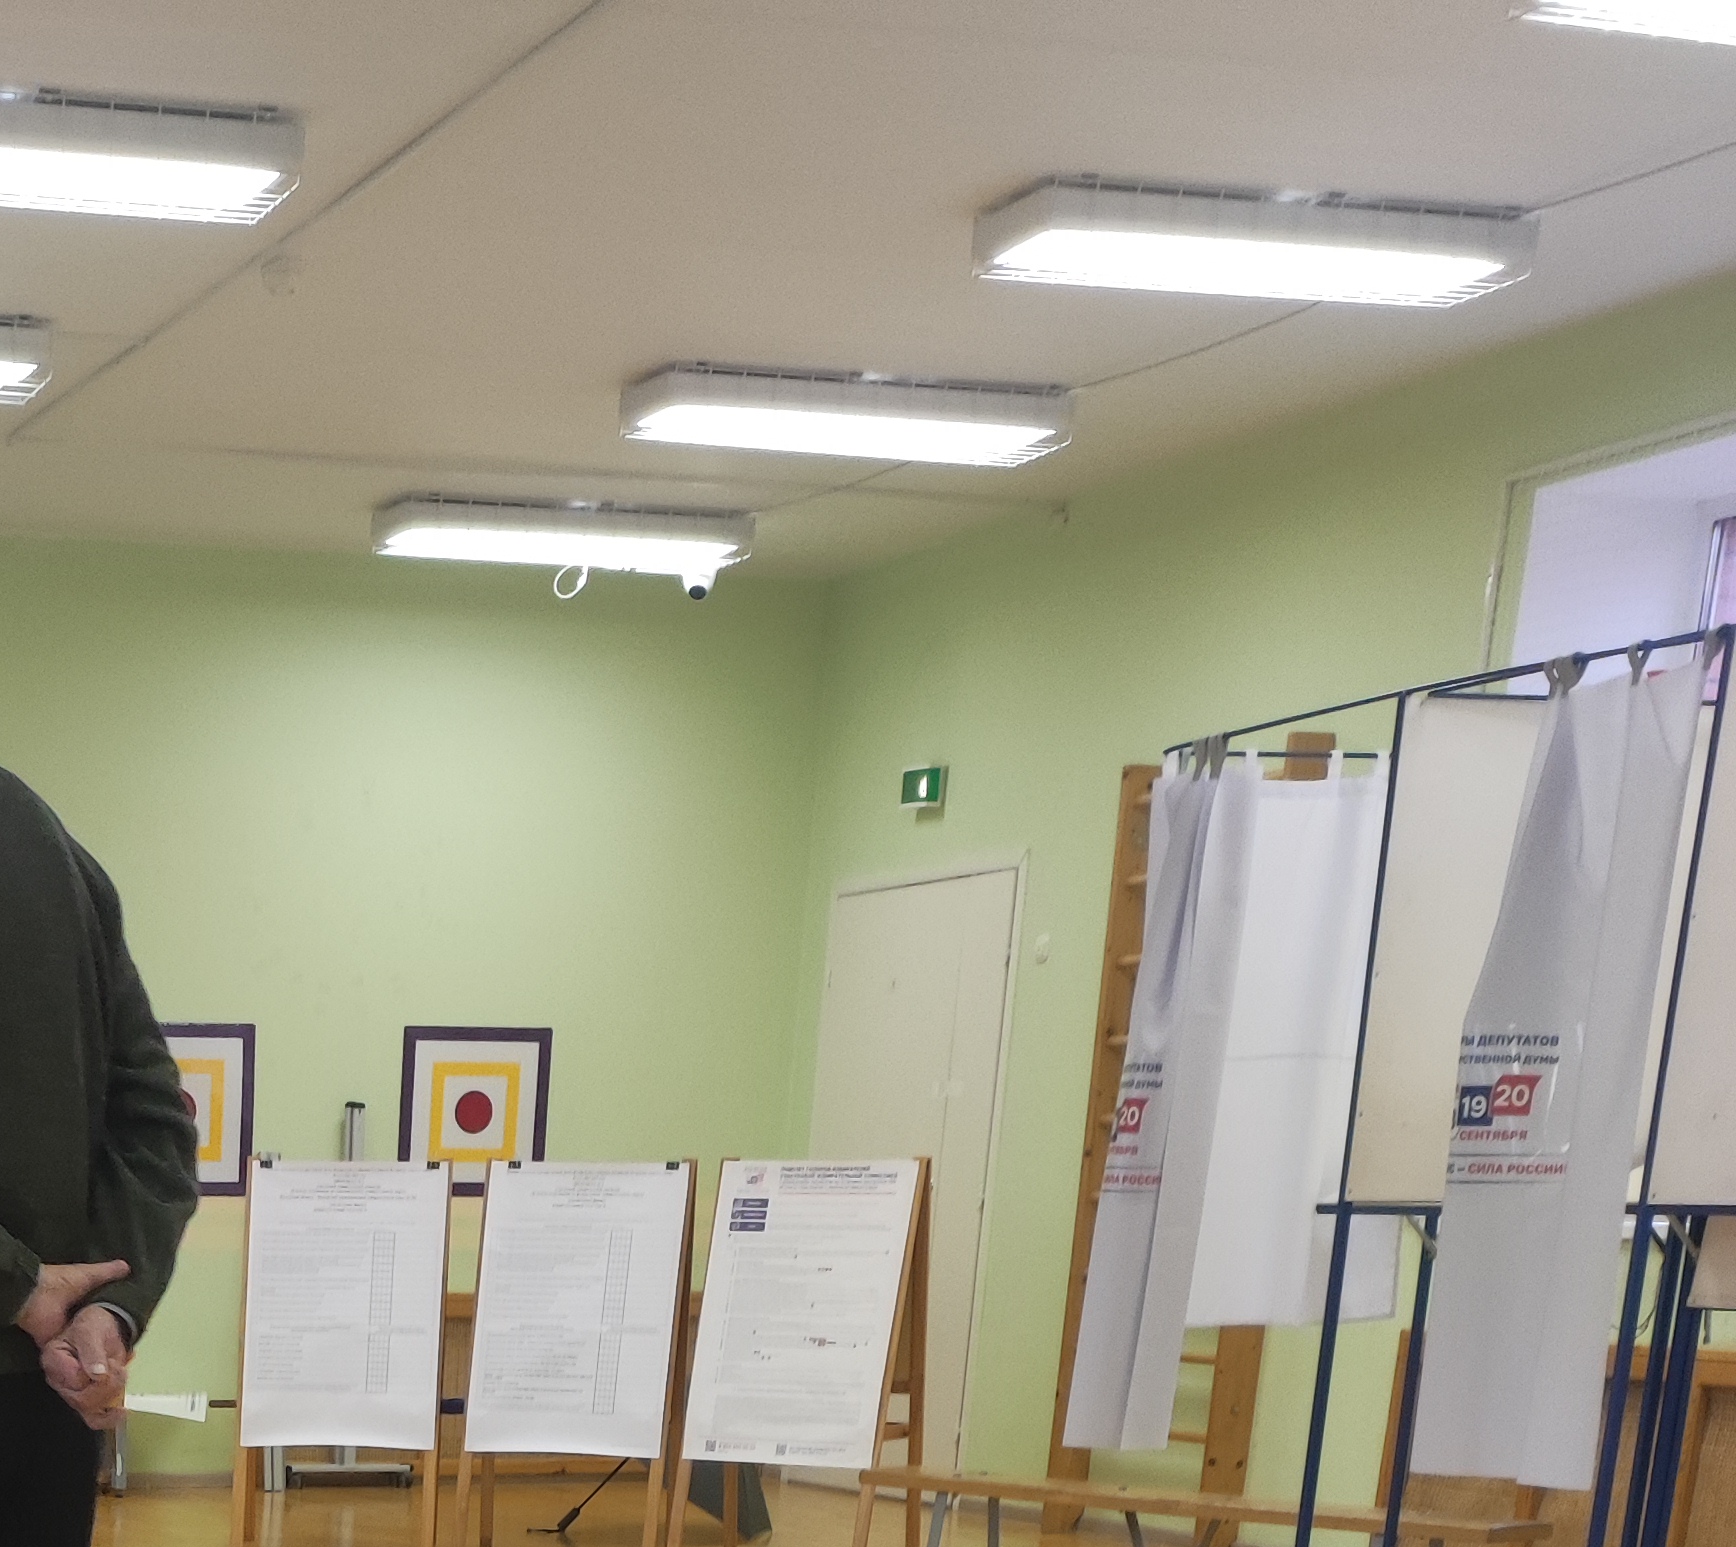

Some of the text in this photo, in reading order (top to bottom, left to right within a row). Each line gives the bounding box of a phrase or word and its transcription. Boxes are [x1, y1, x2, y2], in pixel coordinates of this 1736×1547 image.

[1477, 1035, 1559, 1048] ДЕПУТАТОВ
[1459, 1053, 1560, 1066] СТВЕННОЙ ДУМЫ
[1493, 1084, 1530, 1107] 20
[1461, 1095, 1487, 1119] 19
[1119, 1106, 1140, 1126] 20
[1459, 1130, 1528, 1142] СЕНТЯБРЯ
[1467, 1162, 1504, 1175] СИЛА
